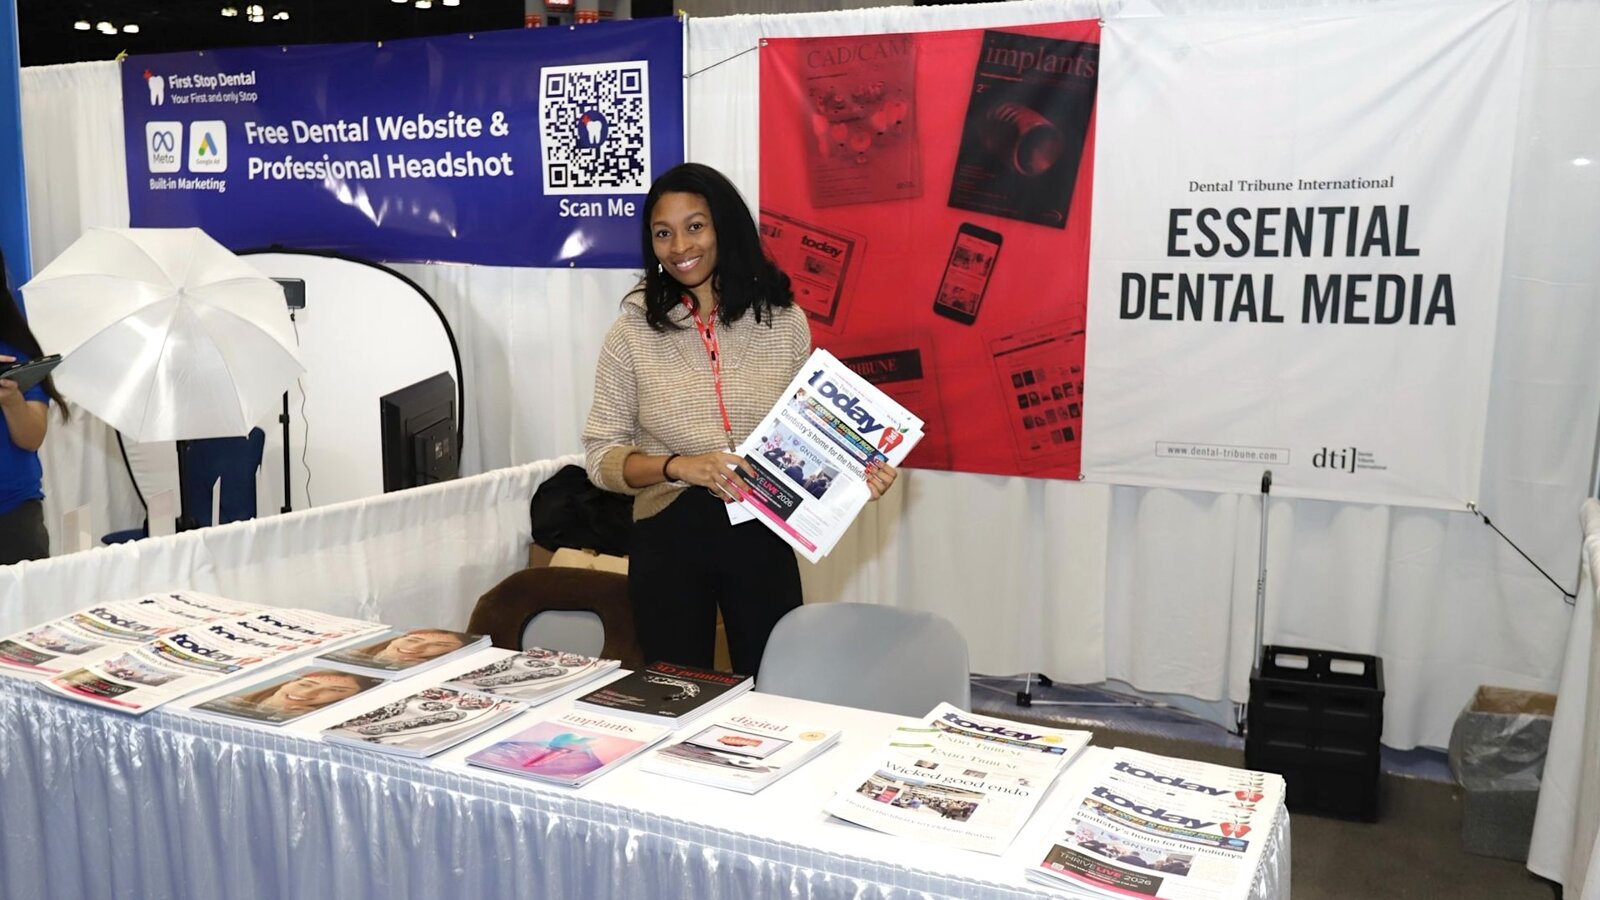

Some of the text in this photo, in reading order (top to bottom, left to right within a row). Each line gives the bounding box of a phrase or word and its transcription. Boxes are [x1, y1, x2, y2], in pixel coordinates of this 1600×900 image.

[984, 40, 1096, 78] implants
[168, 70, 256, 90] First Stop Dental
[171, 91, 258, 104] Your First and only Stop
[244, 111, 510, 144] Free Dental Website &
[153, 154, 175, 164] Meta
[248, 150, 514, 180] Professional Headshot
[149, 177, 226, 193] Built-in Marketing
[1188, 176, 1395, 193] Dental Tribune International
[559, 199, 636, 218] Scan Me
[1167, 204, 1420, 258] ESSENTIAL
[801, 235, 843, 258] today
[1119, 272, 1456, 326] DENTAL MEDIA
[807, 369, 885, 434] today
[781, 408, 867, 482] Dentistry's home for the holiday
[800, 445, 822, 466] GNYDM
[1167, 446, 1278, 460] www.dental-tribune.com
[776, 492, 794, 507] 2026
[563, 712, 637, 732] implants
[731, 715, 789, 733] digital
[942, 713, 1044, 741] today
[886, 761, 1030, 797] Wicked good endo
[1113, 761, 1232, 796] today
[1091, 786, 1217, 830] today
[1076, 811, 1244, 860] Dentistry's home for the holidays
[1122, 839, 1163, 855] GNYDM
[1123, 874, 1152, 887] 2026
